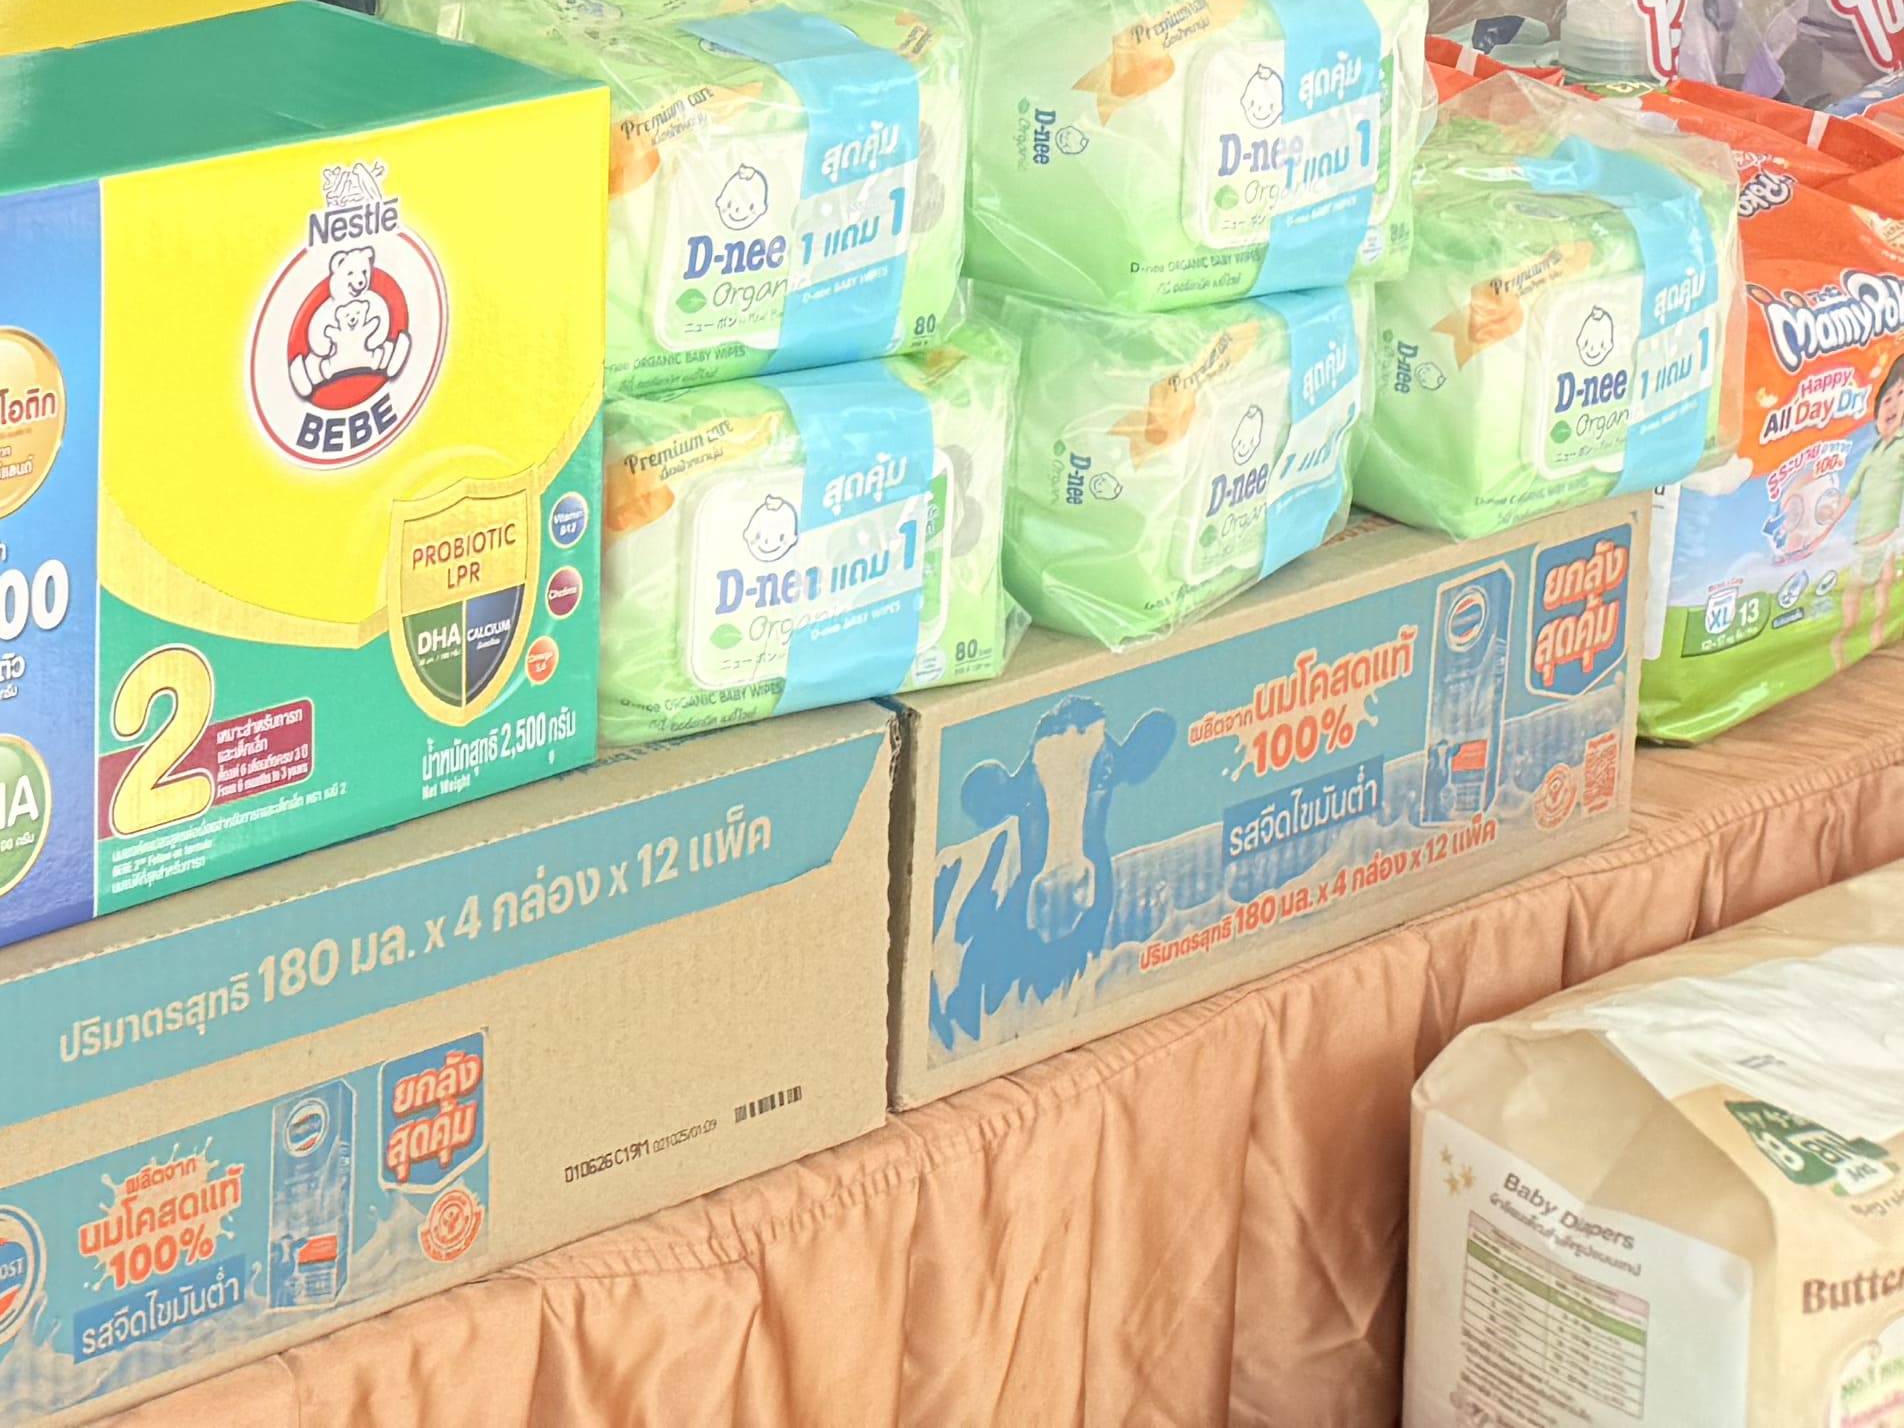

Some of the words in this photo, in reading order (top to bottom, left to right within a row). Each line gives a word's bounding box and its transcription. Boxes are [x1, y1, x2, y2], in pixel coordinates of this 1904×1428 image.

[1299, 50, 1363, 109] สุดคุ้ม
[821, 120, 900, 183] สุดคุ้ม
[1033, 108, 1057, 165] D-nee
[1303, 143, 1351, 185] แถม
[1357, 119, 1372, 169] 1
[801, 232, 814, 265] 1
[824, 215, 879, 258] แถม
[889, 186, 906, 237] 1
[683, 234, 787, 281] D-nee
[913, 313, 937, 336] 80
[1654, 267, 1706, 326] สุดคุ้ม
[1303, 340, 1348, 404] สุดคุ้ม
[1395, 341, 1419, 394] D-nee
[1554, 369, 1629, 414] D-nee
[1639, 370, 1651, 401] 1
[1655, 353, 1694, 394] แถม
[1698, 326, 1711, 371] 1
[1801, 367, 1853, 399] Happy
[296, 392, 398, 454] BEBE
[1763, 408, 1792, 438] All
[1794, 398, 1833, 427] Day
[822, 452, 909, 516] สุดคุ้ม
[1066, 452, 1092, 506] D-nee
[1206, 463, 1270, 518] D-nee
[412, 522, 517, 572] PROBIOTIC
[446, 560, 481, 590] LPR
[831, 549, 891, 594] แถม
[899, 519, 918, 571] 1
[1544, 539, 1628, 612] ยกลัง
[417, 622, 461, 656] DHA
[466, 617, 512, 643] CALCIUM
[1534, 593, 1620, 687] สุดคุ้ม
[1710, 607, 1733, 628] XL
[1739, 597, 1760, 627] 13
[955, 639, 978, 662] 80
[664, 693, 718, 712] ORGANIC
[718, 689, 748, 706] BABY
[1188, 709, 1254, 746] ผลิตจาก
[1253, 625, 1419, 723] นมโคสดแท้
[111, 645, 214, 836] 2
[294, 747, 302, 760] 3
[422, 729, 498, 781] น้ำหนักสุทธิ
[500, 712, 547, 761] 2,500
[547, 706, 577, 742] กรัม
[1250, 704, 1355, 776] 100%
[422, 781, 439, 801] Net
[440, 772, 472, 797] Weight
[1228, 765, 1379, 857] รสจืดไขมันต่ำ
[1139, 916, 1232, 971] ปริมาตรสุทธิ
[1234, 894, 1275, 934] 180
[1281, 885, 1314, 919] มล.
[1316, 883, 1329, 906] x
[1331, 869, 1348, 898] 4
[1351, 851, 1407, 892] กล่อง
[1409, 848, 1422, 872] x
[1425, 831, 1448, 862] 12
[1450, 811, 1498, 857] แพ็ค
[59, 973, 251, 1065] ปริมาตรสุทธิ
[258, 945, 340, 1005] 180
[351, 928, 416, 977] มล.
[423, 920, 447, 953] x
[454, 896, 482, 942] 4
[491, 865, 603, 932] กล่อง
[607, 866, 630, 898] x
[638, 837, 680, 891] 12
[689, 804, 773, 876] แพ็ค
[392, 1049, 482, 1118] ยกลัง
[386, 1099, 477, 1183] สุดคุ้ม
[125, 1154, 197, 1193] ผลิตจาก
[78, 1164, 245, 1257] นมโคสดแท้
[1503, 1171, 1558, 1217] Baby
[1559, 1210, 1636, 1251] Diapers
[108, 1223, 215, 1291] 100%
[80, 1270, 241, 1357] รสจืดไขมันต่ำ
